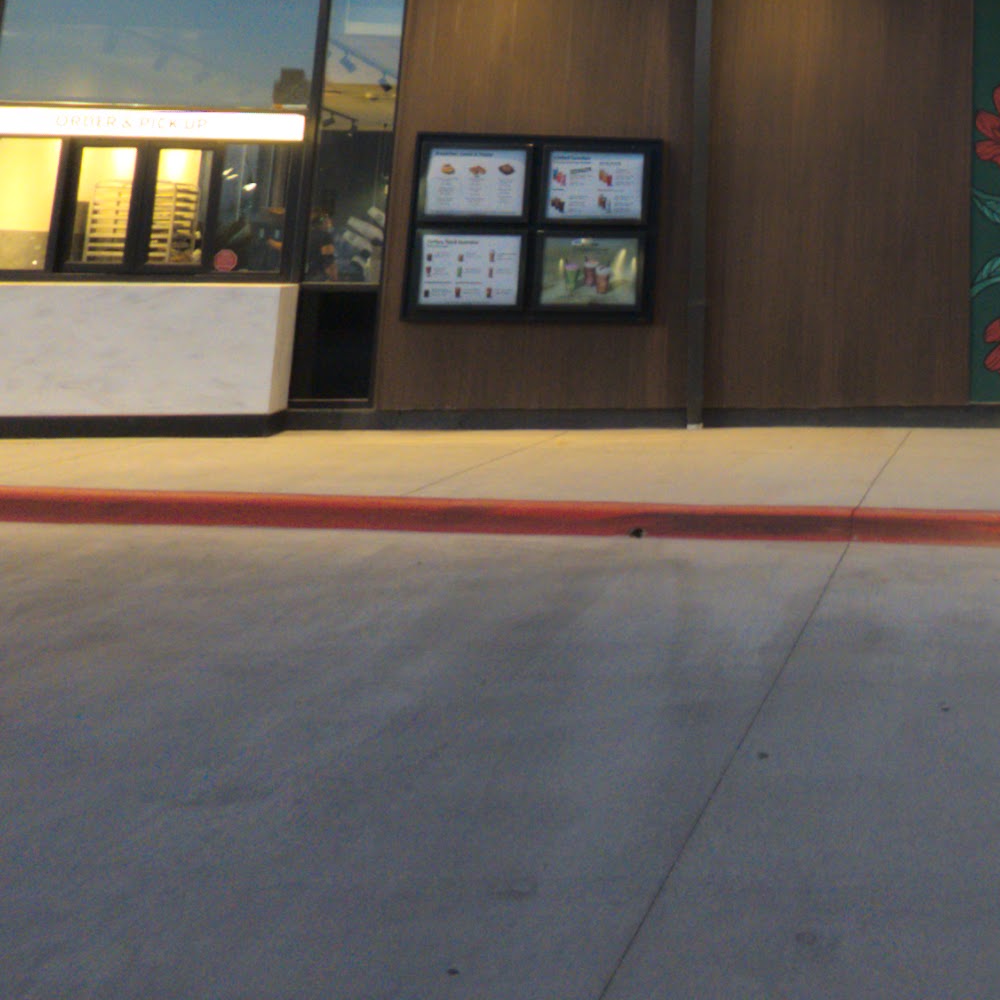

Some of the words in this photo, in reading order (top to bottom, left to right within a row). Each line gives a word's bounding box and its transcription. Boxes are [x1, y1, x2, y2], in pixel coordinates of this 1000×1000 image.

[56, 114, 117, 128] ORDER
[121, 118, 133, 129] &
[139, 117, 178, 129] PICK
[184, 118, 208, 130] UP
